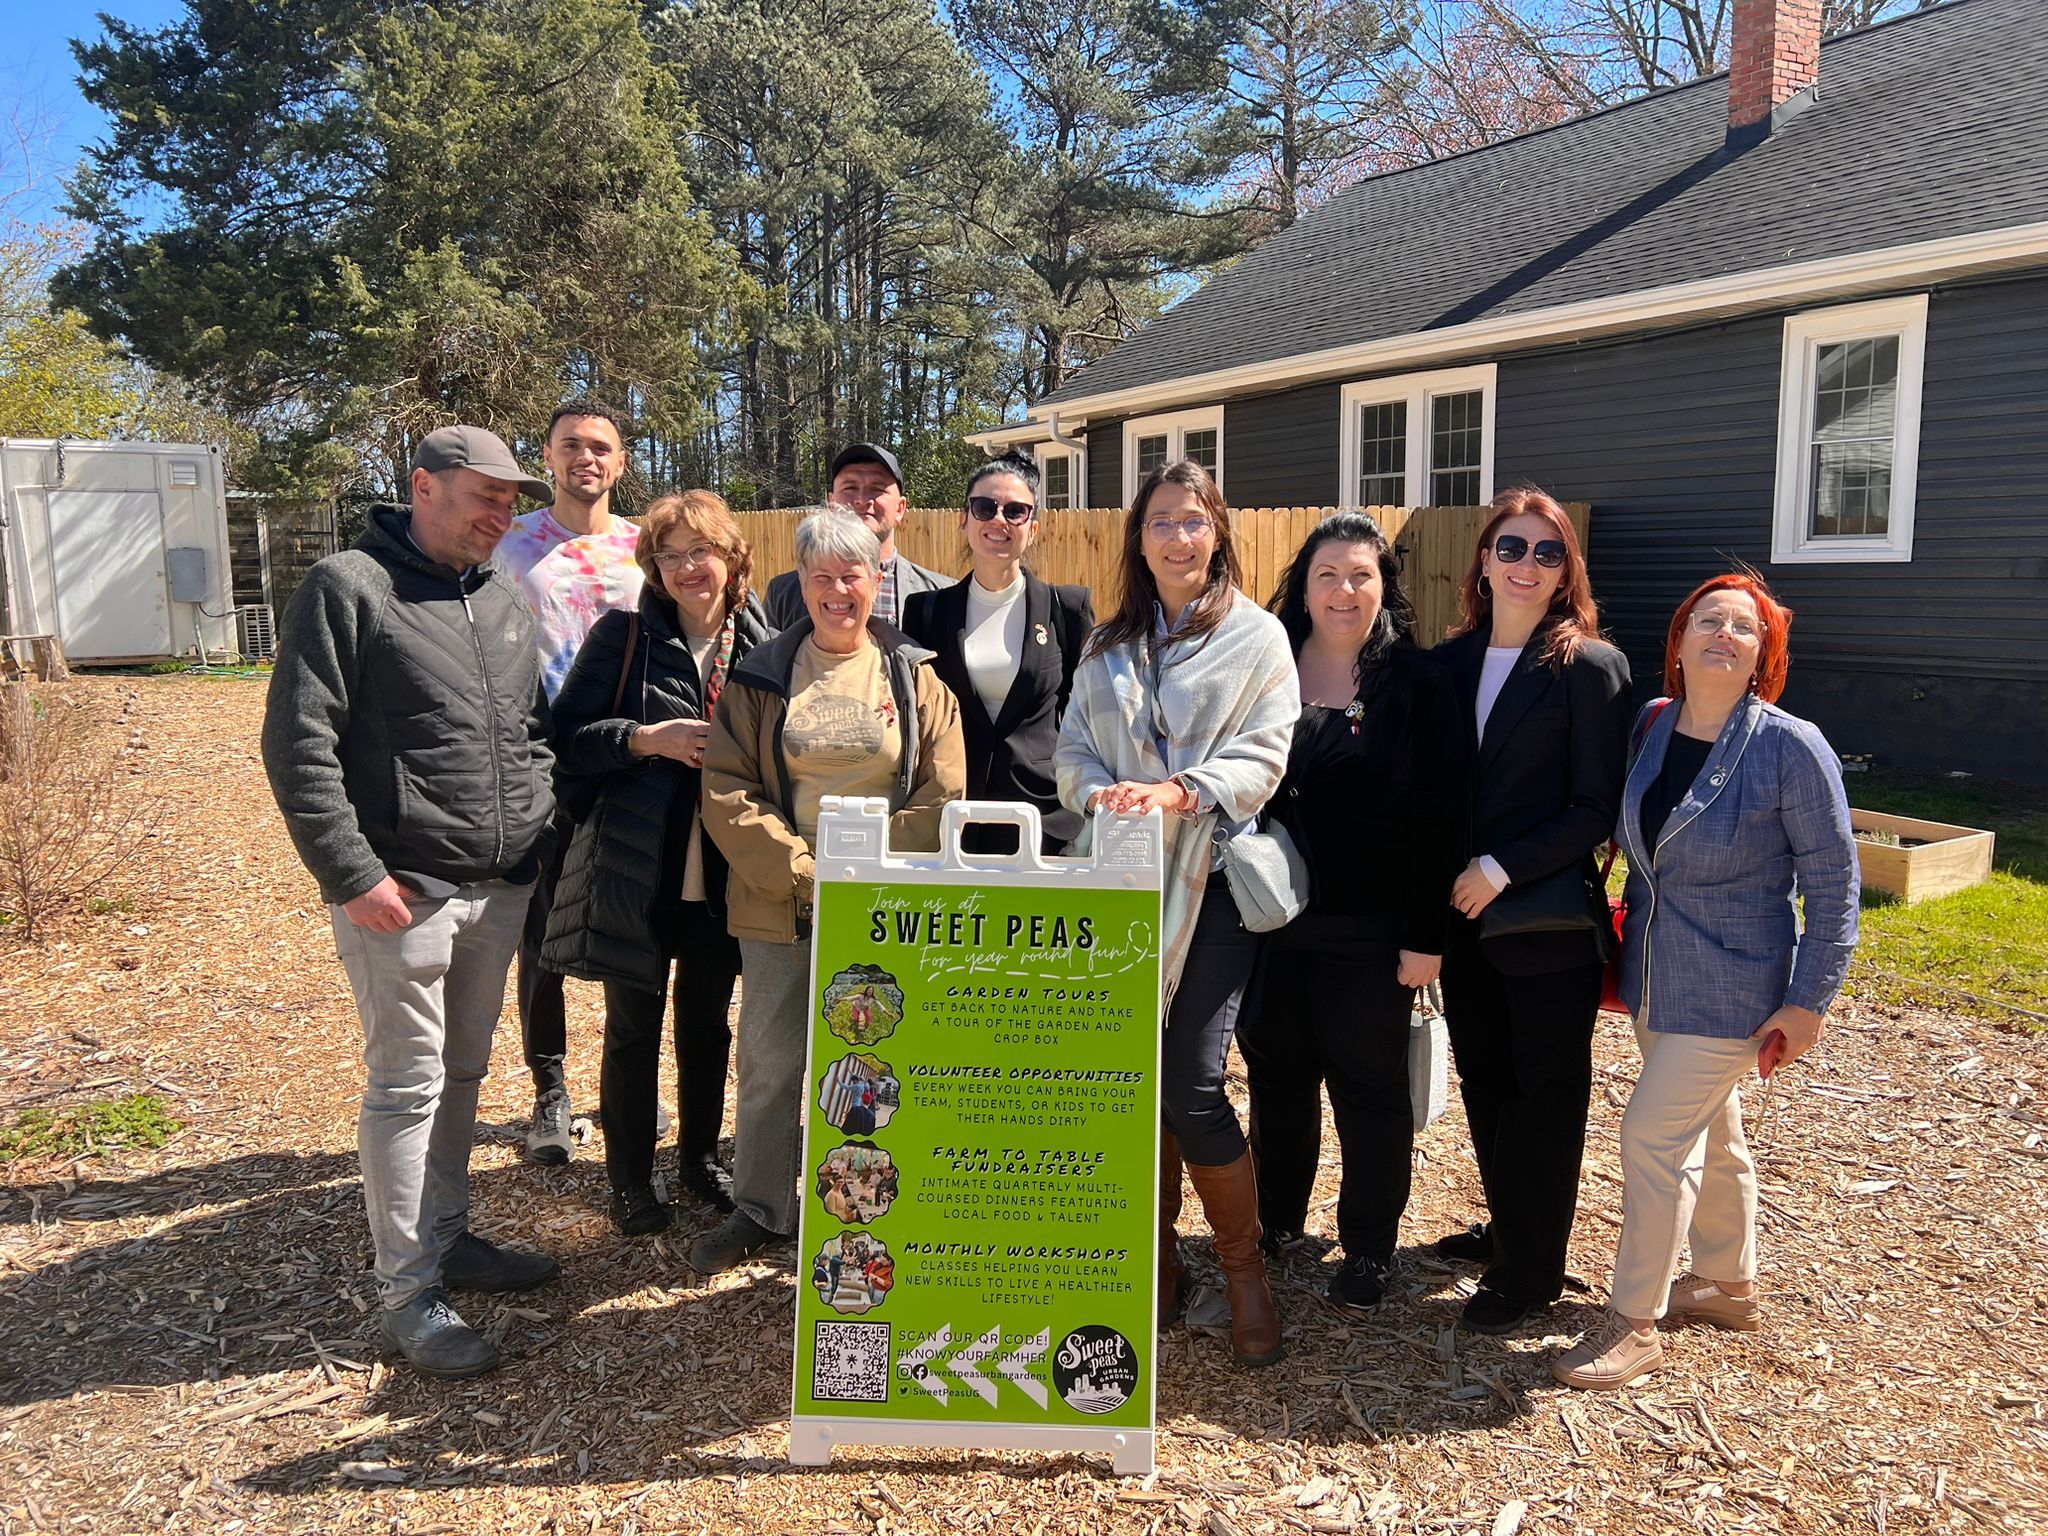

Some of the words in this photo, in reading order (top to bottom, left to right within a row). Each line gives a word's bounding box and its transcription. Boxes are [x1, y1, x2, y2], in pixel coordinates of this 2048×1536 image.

[792, 702, 869, 731] Sweet
[826, 719, 859, 738] peas
[867, 887, 911, 912] Join
[923, 897, 946, 914] us
[958, 891, 986, 914] at
[870, 910, 986, 946] SWEET
[1006, 916, 1094, 949] PEAS
[919, 946, 952, 972] For
[964, 952, 1008, 974] year
[1020, 936, 1077, 968] round
[1085, 936, 1129, 972] fun!
[947, 986, 1028, 998] GARDEN
[1043, 989, 1109, 1001] TOURS
[923, 1002, 944, 1011] GET
[952, 1003, 984, 1013] BACK
[991, 1004, 1006, 1013] TO
[1013, 1005, 1062, 1015] NATURE
[1069, 1007, 1094, 1016] AND
[1101, 1008, 1132, 1017] TAKE
[933, 1017, 939, 1025] A
[947, 1018, 978, 1027] TOUR
[986, 1019, 1001, 1027] OF
[1008, 1019, 1031, 1029] THE
[1038, 1020, 1088, 1030] GARDEN
[1096, 1022, 1121, 1031] AND
[995, 1034, 1028, 1043] CROP
[1035, 1035, 1057, 1044] BOX
[909, 1065, 1001, 1078] VOLUNTEER
[1009, 1068, 1143, 1082] OPPORTUNITIES
[914, 1082, 953, 1091] EVERY
[959, 1084, 990, 1093] WEEK
[997, 1085, 1020, 1094] YOU
[1027, 1086, 1051, 1095] CAN
[1059, 1087, 1096, 1096] BRING
[1103, 1088, 1135, 1097] YOUR
[915, 1097, 951, 1108] TEAM,
[958, 1099, 1024, 1111] STUDENTS,
[1032, 1101, 1048, 1110] OR
[1055, 1102, 1083, 1111] KIDS
[1090, 1103, 1105, 1112] TO
[1112, 1103, 1134, 1113] GET
[958, 1114, 994, 1123] THEIR
[1001, 1115, 1043, 1125] HANDS
[1050, 1116, 1086, 1126] DIRTY
[933, 1147, 987, 1159] FARM
[1002, 1149, 1025, 1160] TO
[1040, 1150, 1104, 1162] TABLE
[952, 1161, 1095, 1175] FUNDRAISERS
[923, 1178, 986, 1189] INTIMATE
[993, 1180, 1071, 1191] QUARTERLY
[1077, 1183, 1122, 1193] MULTI-
[918, 1193, 979, 1203] COURSED
[986, 1195, 1044, 1205] DINNERS
[1052, 1197, 1126, 1208] FEATURING
[945, 1209, 986, 1219] LOCAL
[994, 1211, 1030, 1220] FOOD
[1051, 1212, 1099, 1222] TALENT
[905, 1243, 995, 1256] MONTHLY
[1007, 1246, 1127, 1260] WORKSHOPS
[921, 1260, 977, 1271] CLASSES
[985, 1263, 1039, 1273] HELPING
[1046, 1265, 1069, 1274] YOU
[1076, 1266, 1117, 1276] LEARN
[906, 1276, 931, 1285] NEW
[938, 1277, 981, 1287] SKILLS
[988, 1278, 1002, 1287] TO
[1010, 1279, 1038, 1289] LIVE
[1045, 1280, 1052, 1289] A
[1059, 1281, 1131, 1292] HEALTHIER
[983, 1294, 1053, 1304] LIFESTYLE!
[898, 1330, 937, 1342] SCAN
[943, 1332, 972, 1343] OUR
[978, 1333, 998, 1344] QR
[1005, 1335, 1049, 1346] CODE!
[896, 1349, 1047, 1363] #KNOWYOURFARMHER
[1058, 1334, 1125, 1369] Sweet
[1086, 1354, 1117, 1377] peas
[929, 1369, 1048, 1381] sweetpeasurbangardens
[1099, 1374, 1134, 1382] GARDENS
[912, 1387, 980, 1398] SweetPeasUG
